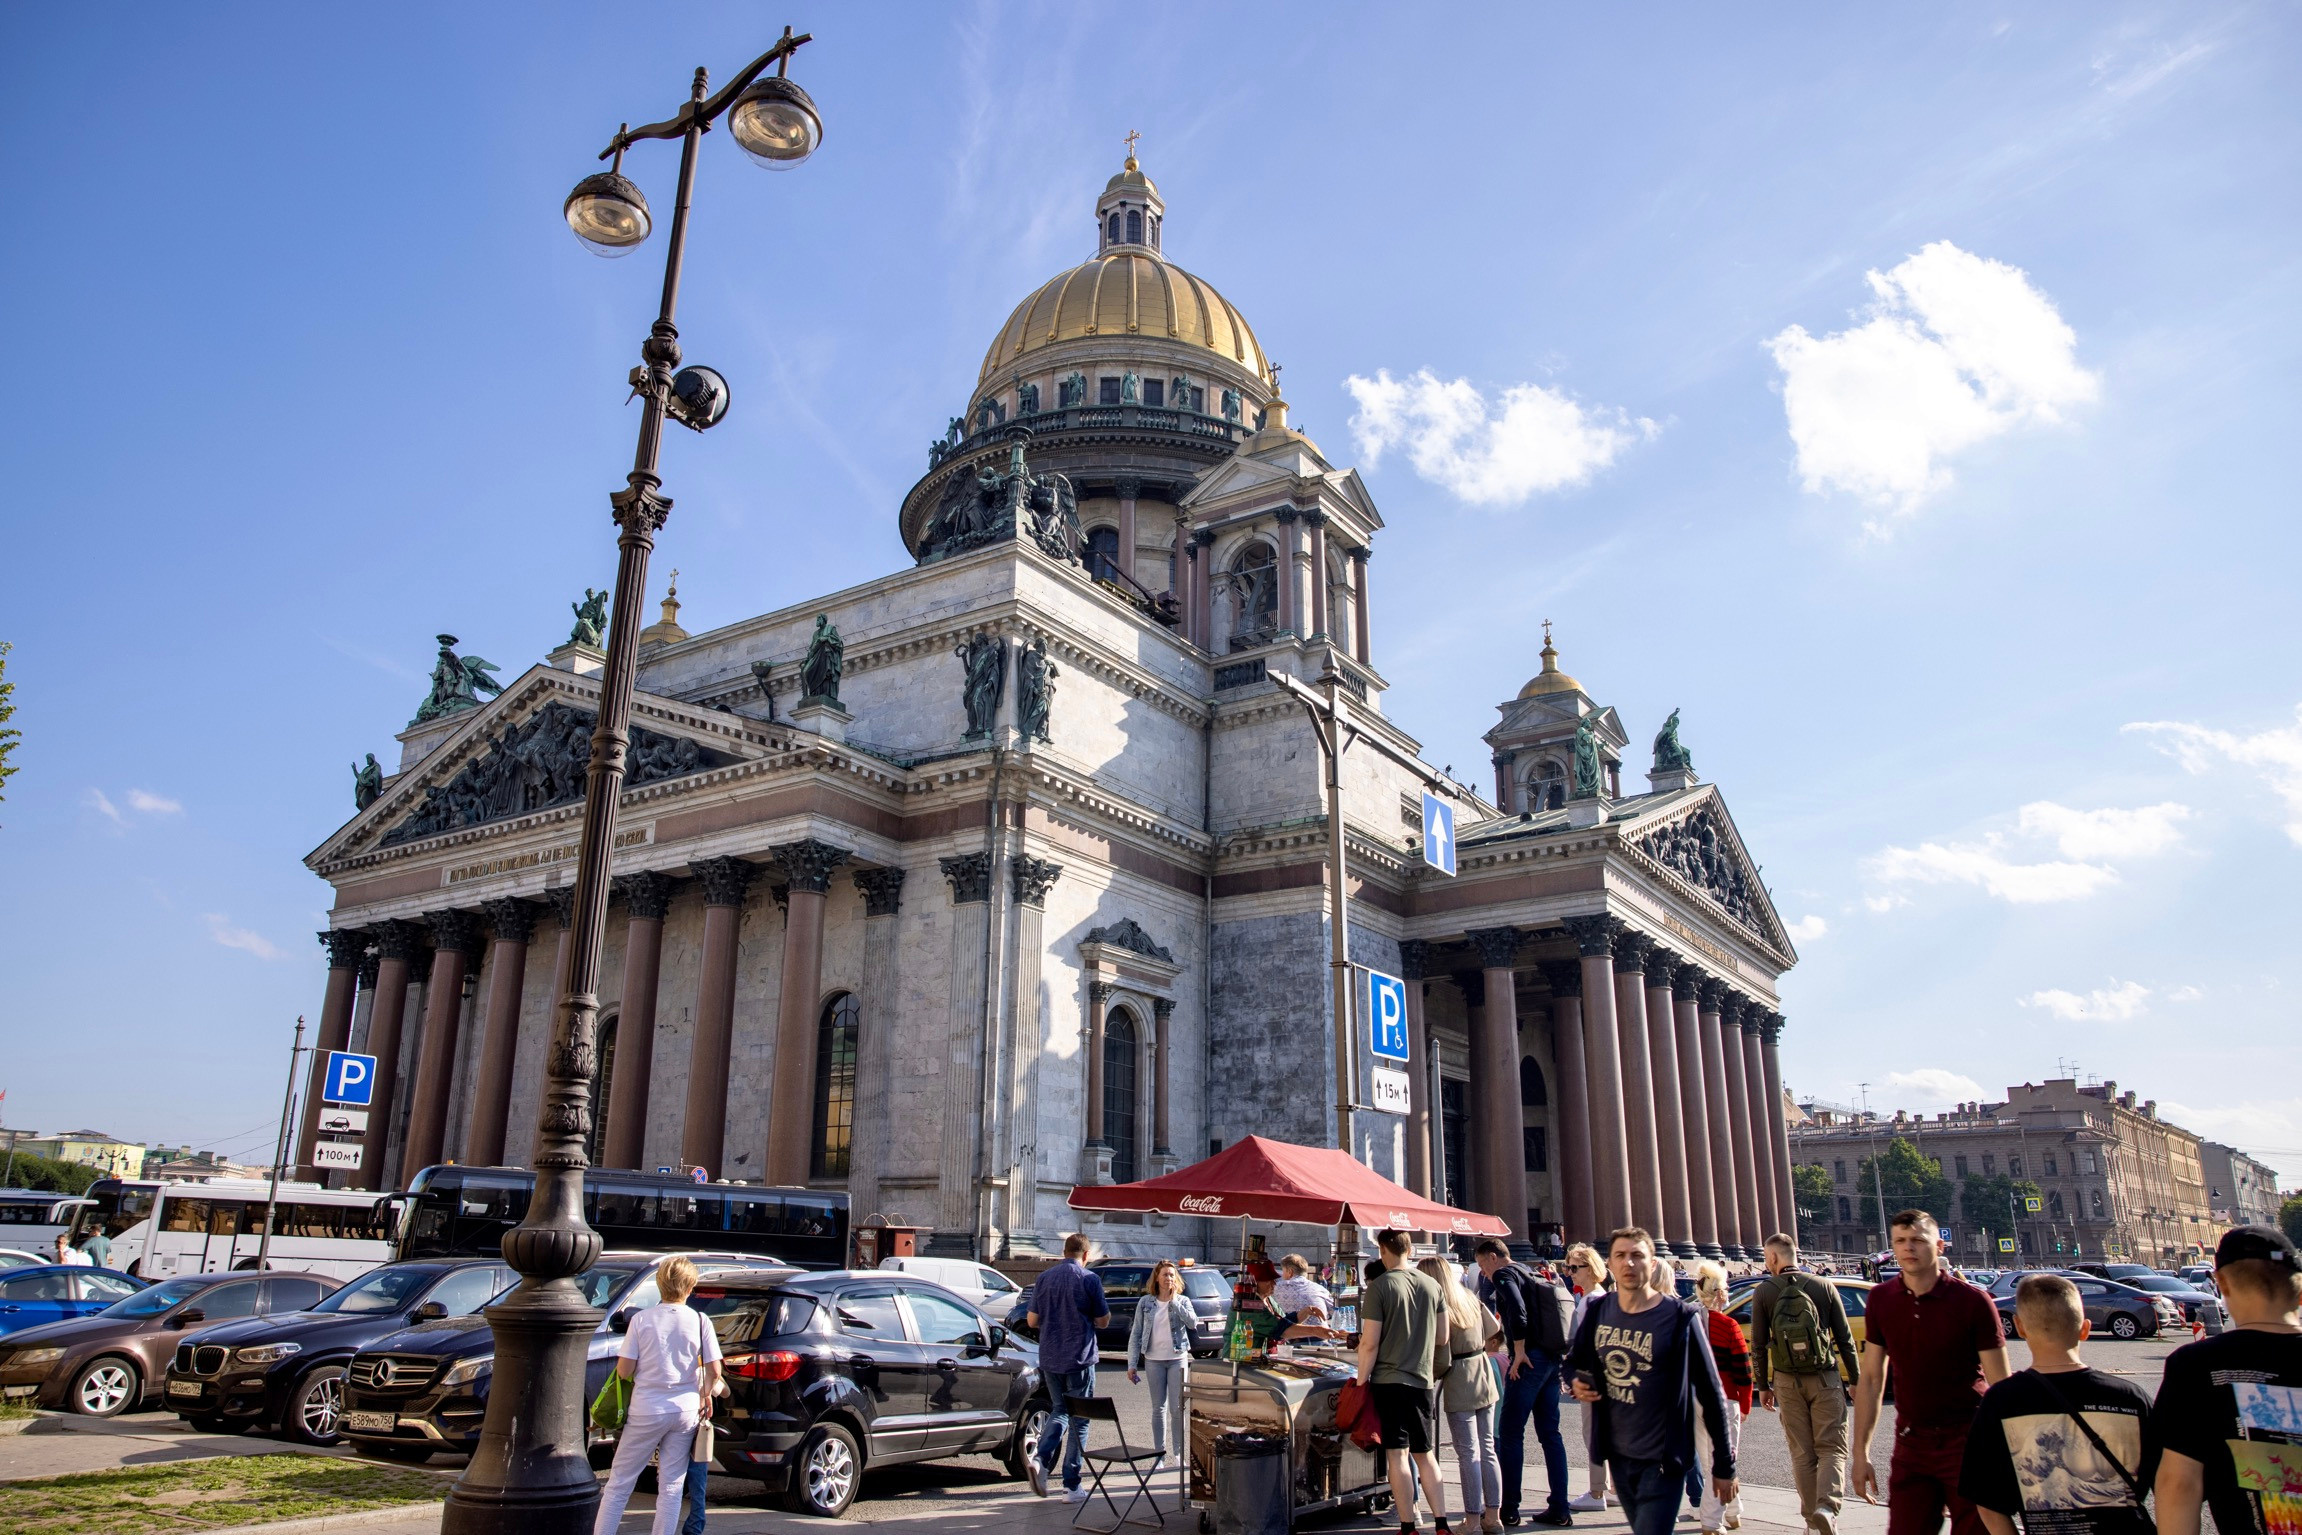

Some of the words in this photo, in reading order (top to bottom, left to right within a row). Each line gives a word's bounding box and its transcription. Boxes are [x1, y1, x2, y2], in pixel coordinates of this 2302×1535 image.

[1379, 983, 1401, 1047] P
[337, 1058, 366, 1097] P
[1179, 1194, 1224, 1213] Coca-Cola
[1594, 1324, 1653, 1363] ITALIA
[380, 1415, 393, 1425] 750
[2098, 1404, 2119, 1412] GREAT
[2120, 1407, 2138, 1415] WAVE
